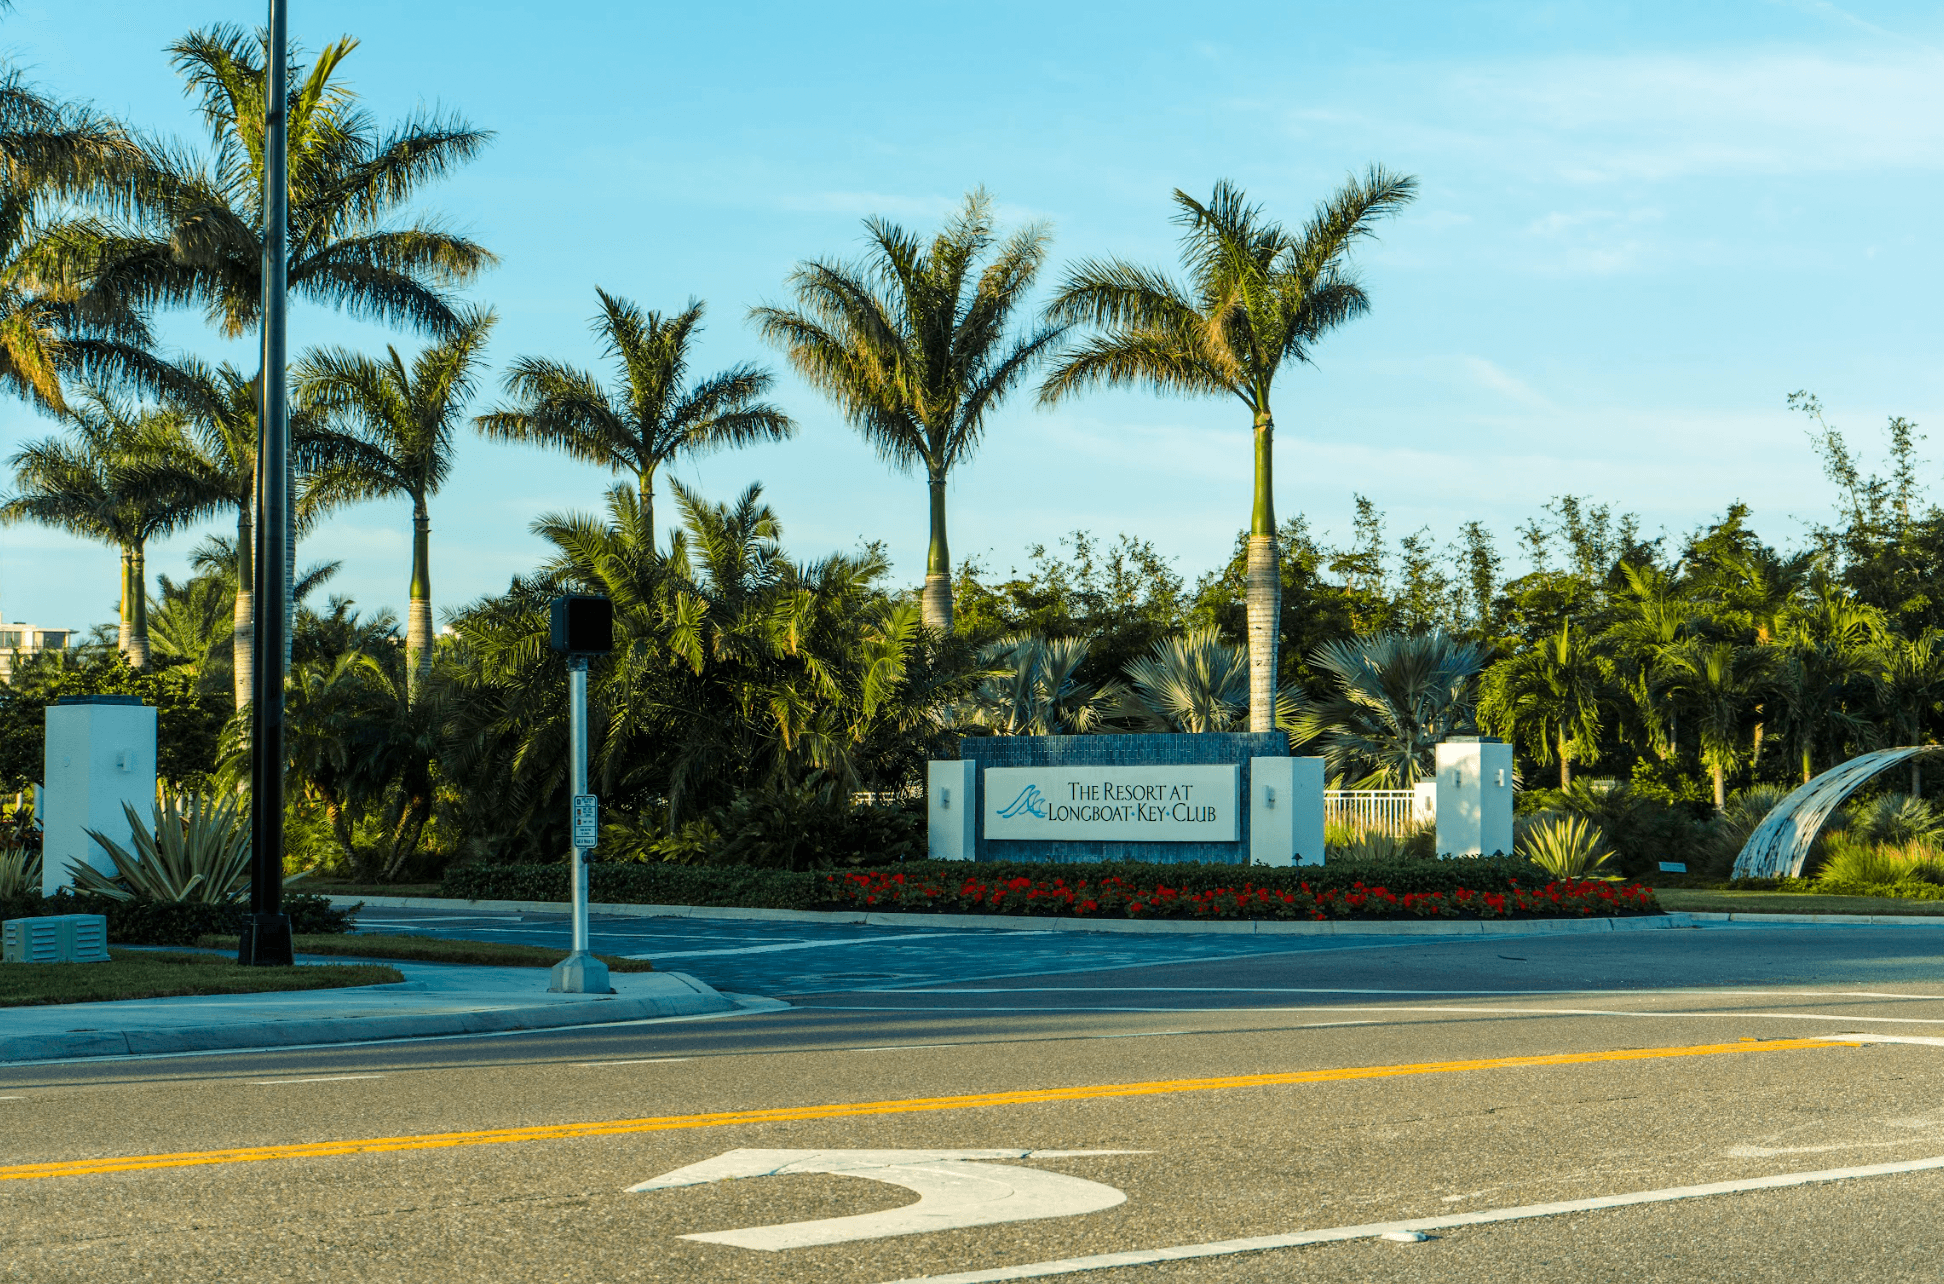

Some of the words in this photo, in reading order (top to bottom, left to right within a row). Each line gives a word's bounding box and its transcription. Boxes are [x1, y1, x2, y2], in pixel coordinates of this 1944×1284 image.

[1067, 781, 1100, 801] THE
[1104, 781, 1167, 801] RESORT
[1169, 784, 1194, 801] AT
